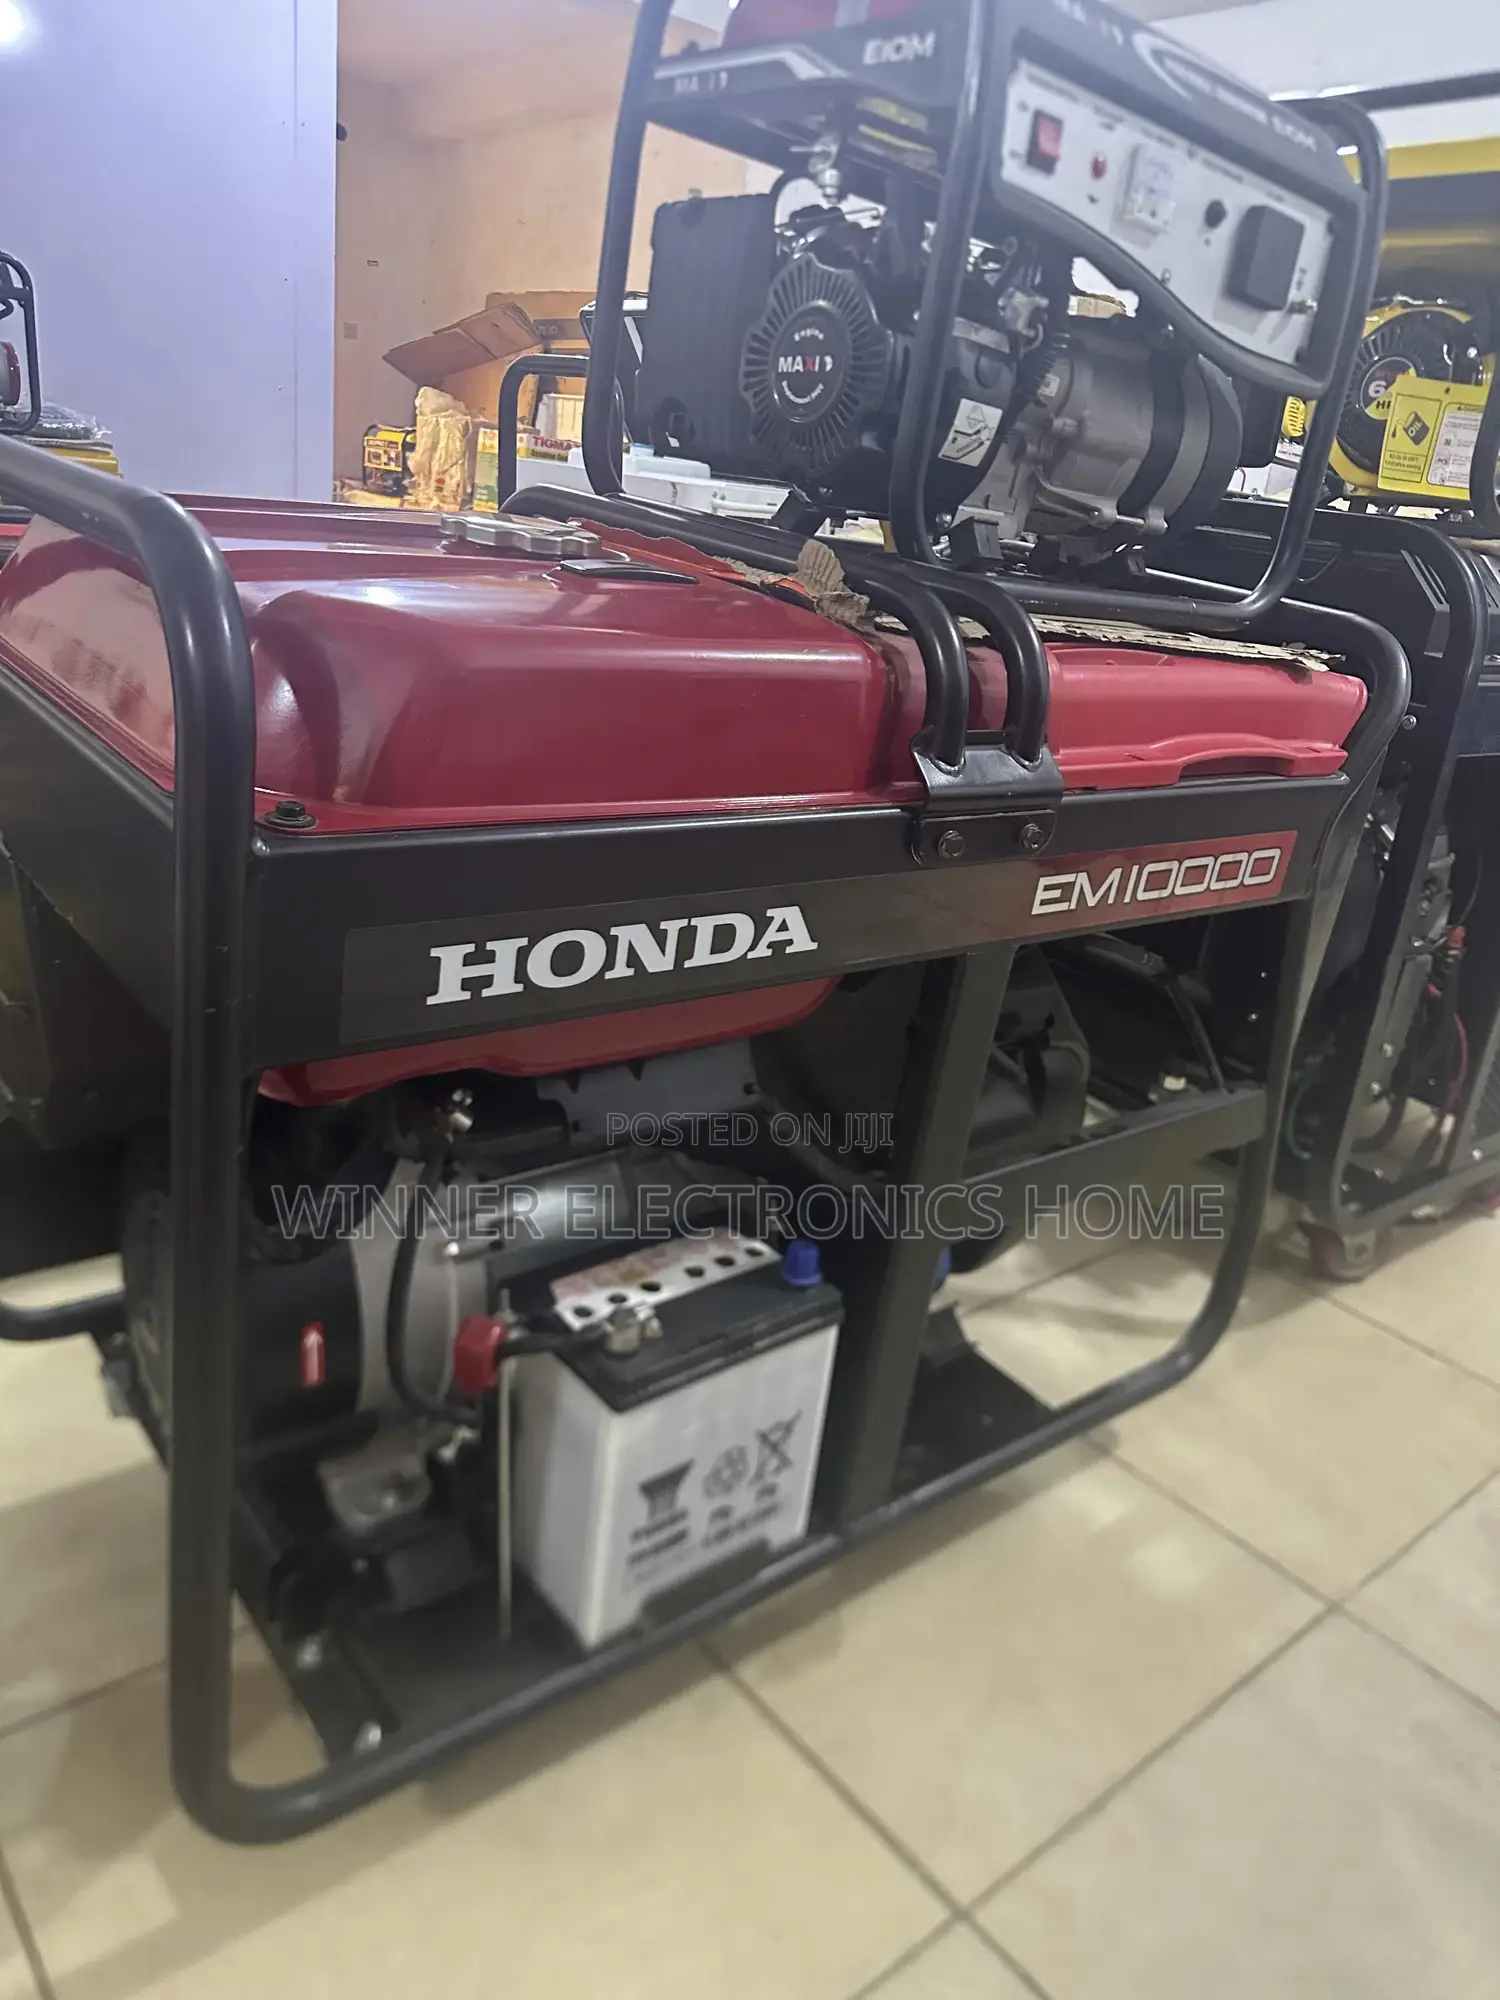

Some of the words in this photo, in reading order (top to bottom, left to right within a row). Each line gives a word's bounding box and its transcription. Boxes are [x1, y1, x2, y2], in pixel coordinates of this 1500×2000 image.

[1407, 420, 1423, 437] OIL
[1031, 848, 1282, 915] EM10000
[426, 905, 818, 1006] HONDA
